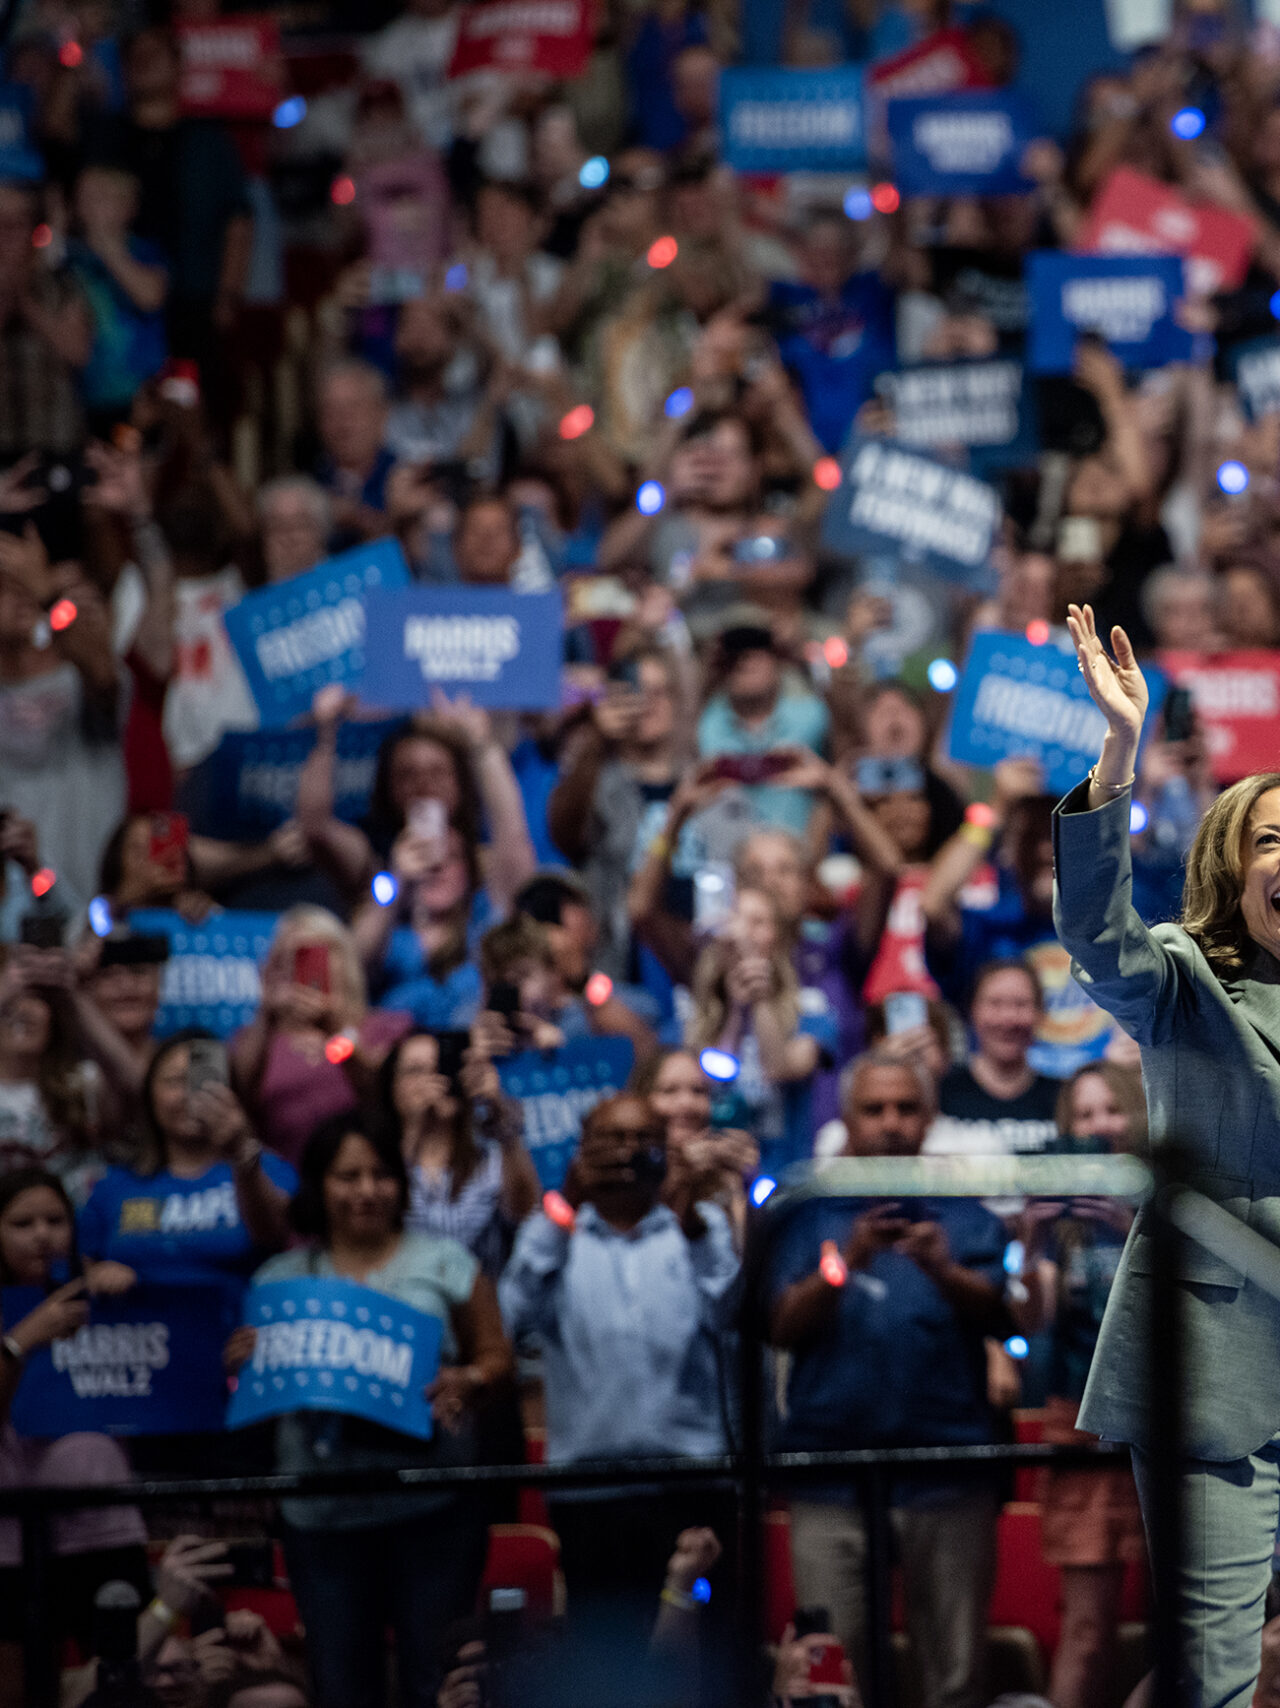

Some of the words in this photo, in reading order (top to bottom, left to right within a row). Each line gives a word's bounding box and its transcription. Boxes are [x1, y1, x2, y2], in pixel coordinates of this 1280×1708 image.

[404, 615, 521, 661] HARRIS
[419, 652, 502, 682] WALZ
[51, 1322, 170, 1372] HARRIS
[252, 1318, 414, 1389] FREEDOM
[68, 1364, 153, 1398] WALZ
